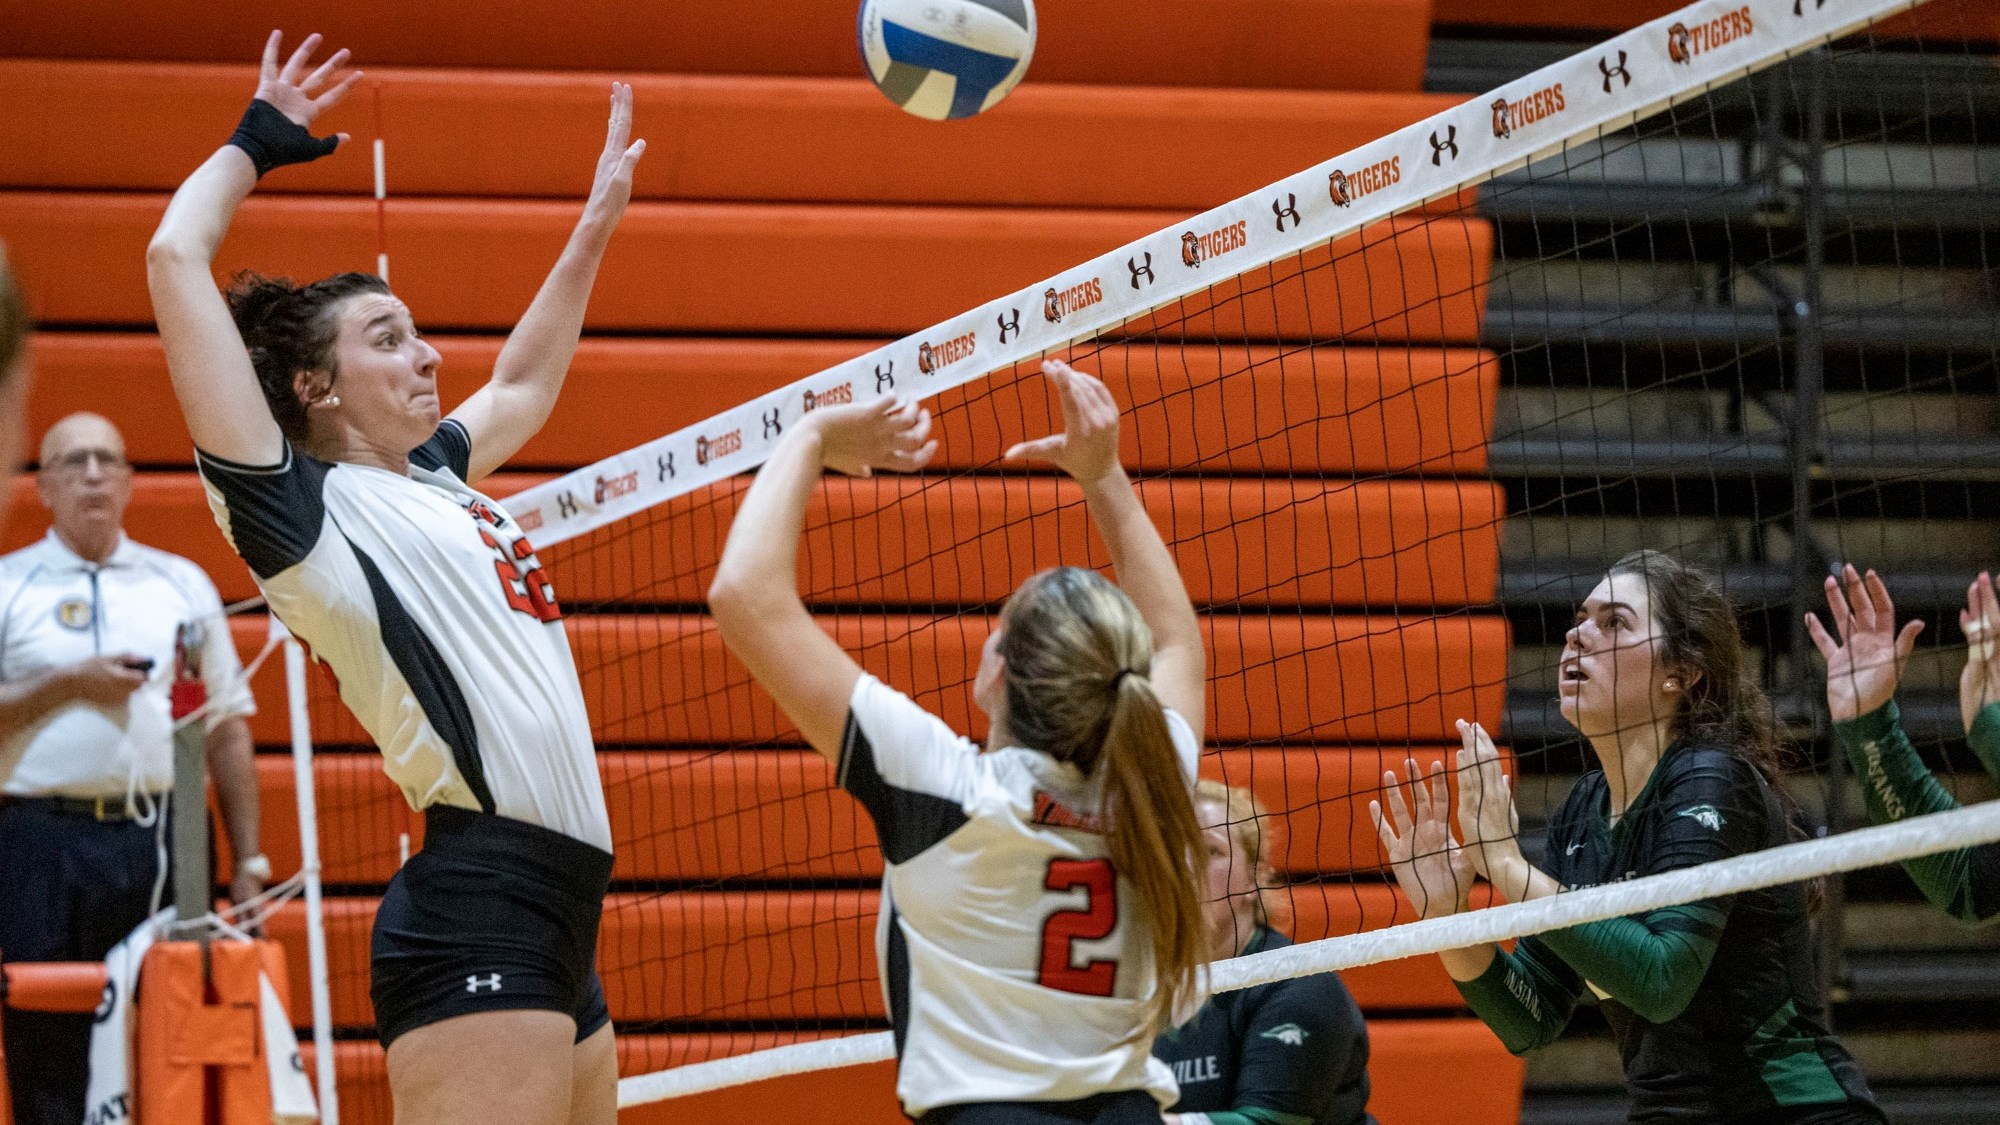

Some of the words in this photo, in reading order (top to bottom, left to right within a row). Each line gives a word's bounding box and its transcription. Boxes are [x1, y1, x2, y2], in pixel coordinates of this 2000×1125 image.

[1689, 6, 1753, 57] TIGERS
[1508, 82, 1565, 131] TIGERS
[1347, 155, 1400, 201] TIGERS
[1198, 220, 1246, 262] TIGERS
[1058, 277, 1103, 318] TIGERS
[932, 331, 976, 369] TIGERS
[814, 381, 853, 408] TIGERS
[1037, 856, 1118, 998] 2
